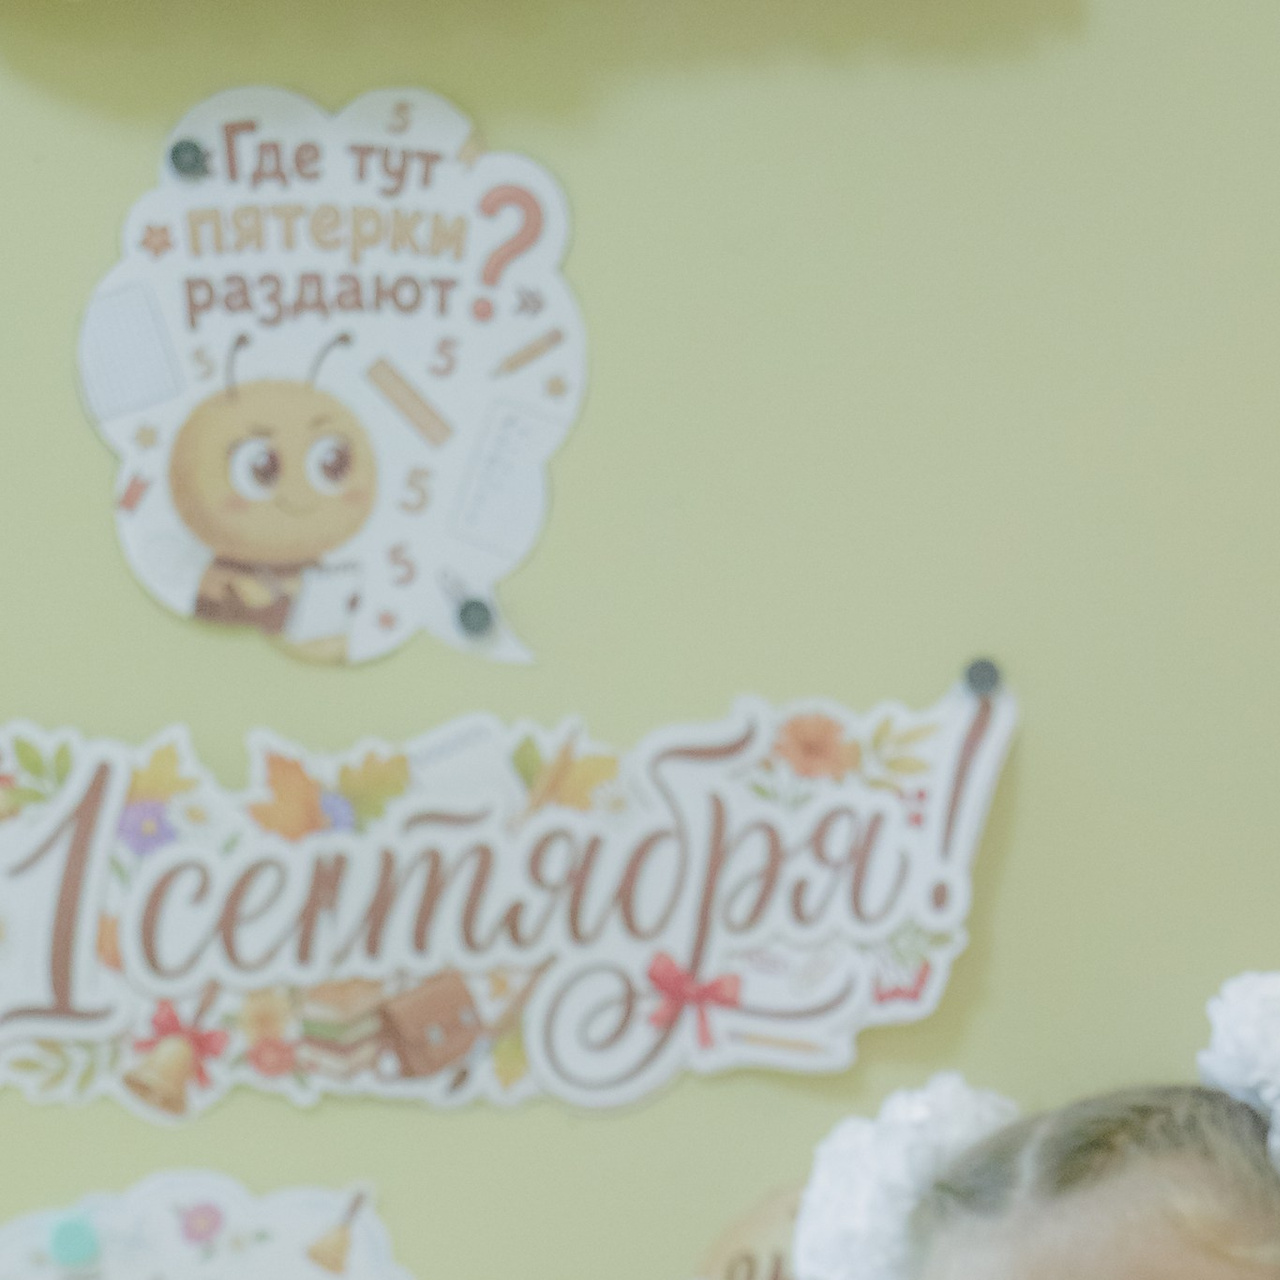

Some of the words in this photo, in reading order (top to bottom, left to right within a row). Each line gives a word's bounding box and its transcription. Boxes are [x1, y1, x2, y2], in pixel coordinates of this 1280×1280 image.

[221, 119, 322, 191] Где
[350, 142, 445, 197] тут
[186, 204, 468, 265] пятерки
[184, 271, 458, 330] раздают
[0, 760, 115, 1020] 1
[138, 694, 995, 1088] сентября!
